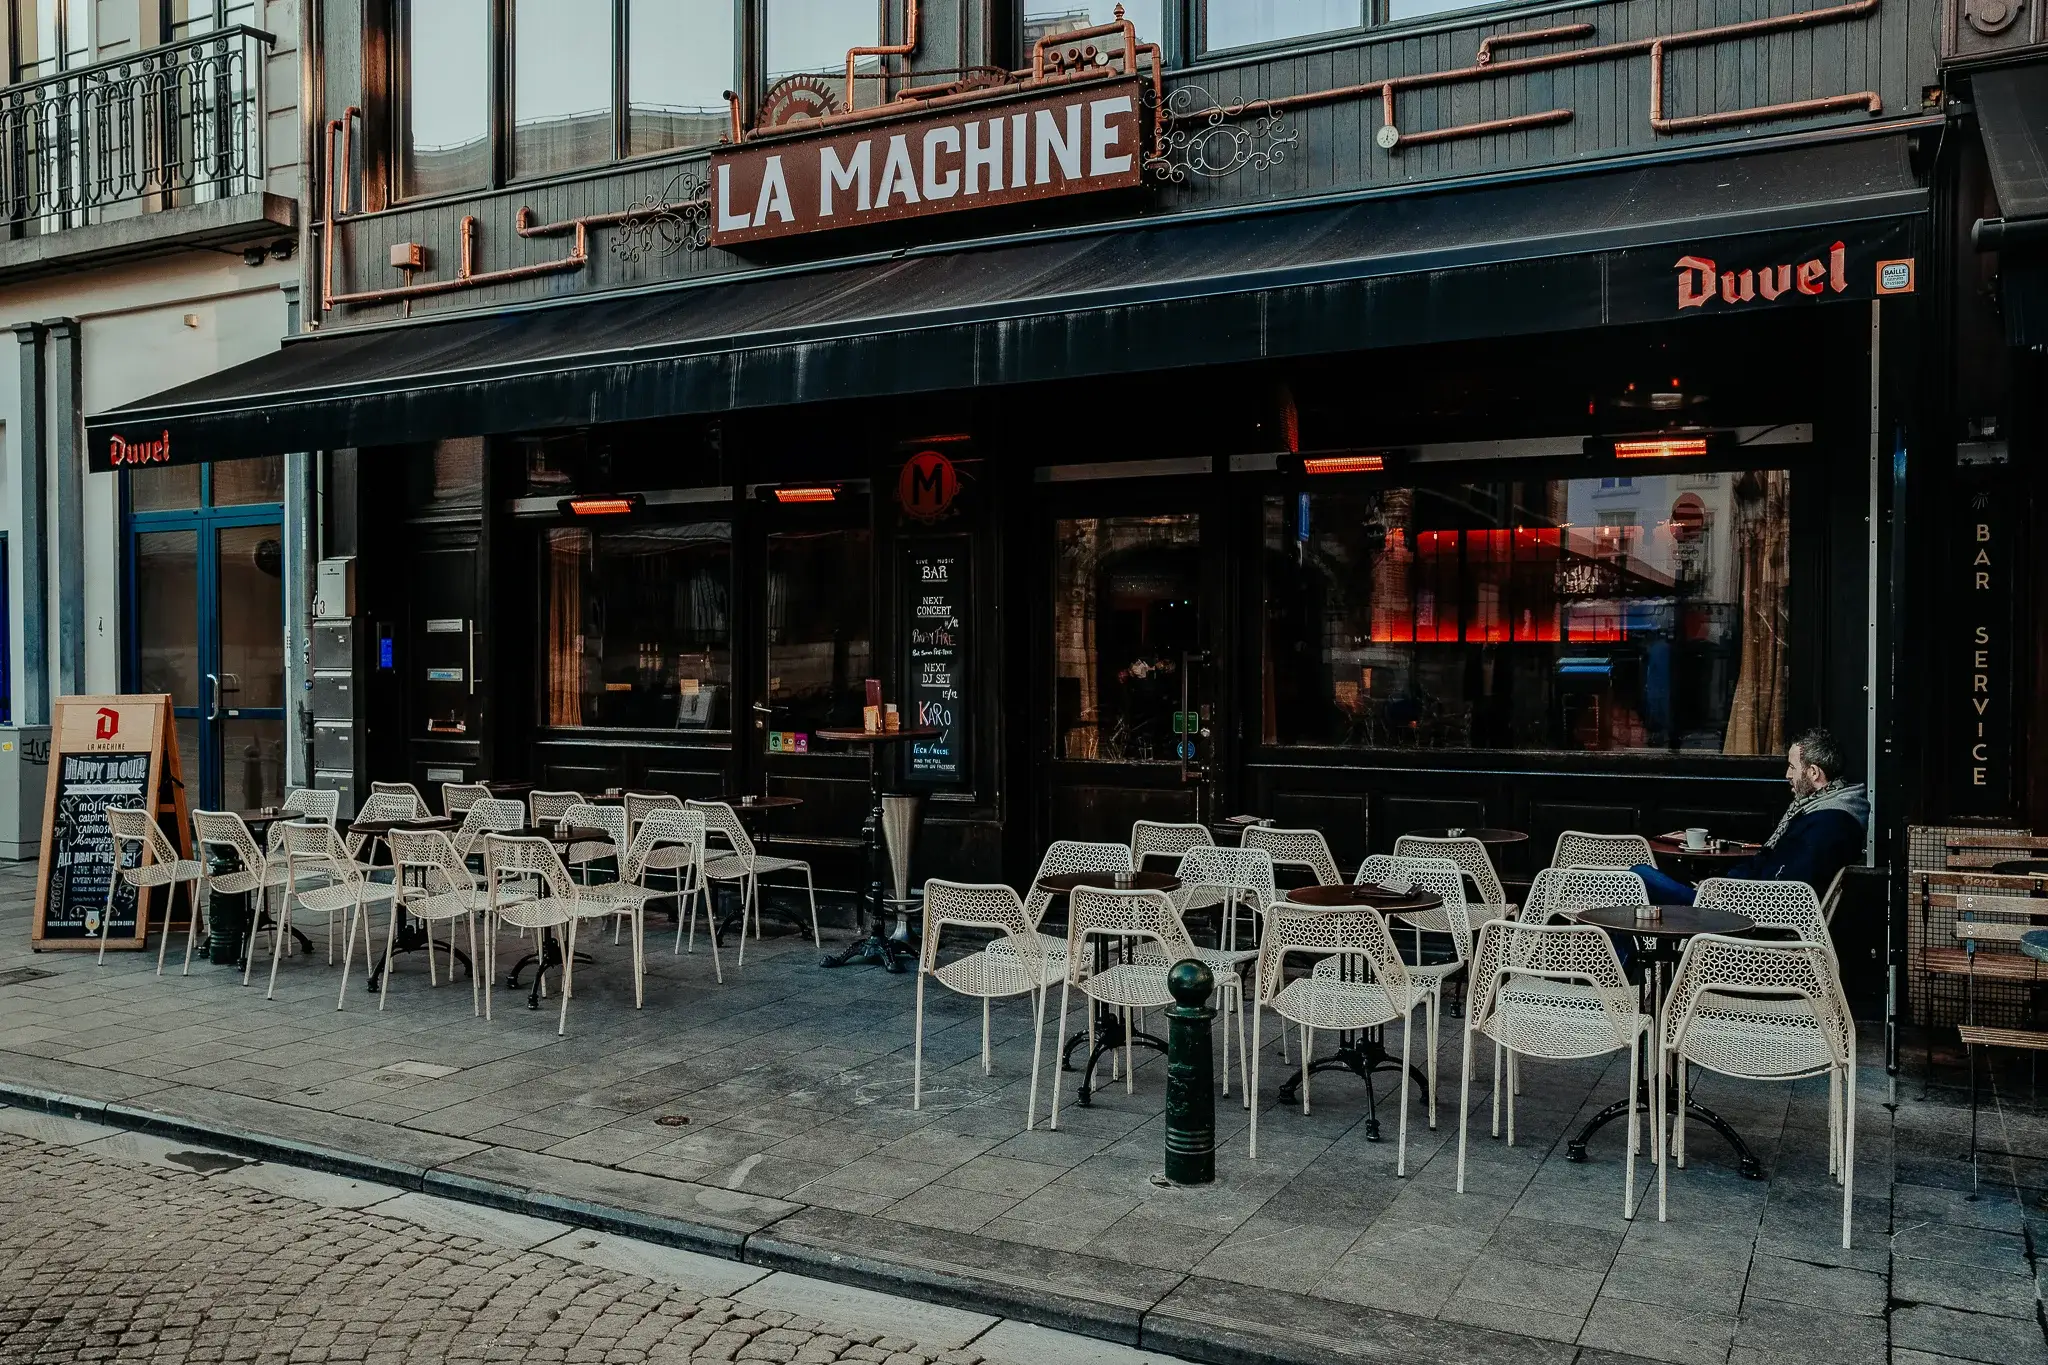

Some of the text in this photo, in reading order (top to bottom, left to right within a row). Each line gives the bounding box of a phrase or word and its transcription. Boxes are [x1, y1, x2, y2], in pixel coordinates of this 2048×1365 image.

[717, 95, 1133, 232] LA MACHINE
[1674, 241, 1848, 309] Duvel
[110, 429, 170, 466] Duvel
[913, 463, 942, 505] M
[922, 565, 949, 579] BAR
[916, 606, 952, 615] CONCERT
[922, 596, 944, 605] NEXT
[1972, 523, 1991, 785] BAR SERVICE
[924, 663, 947, 672] NEXT
[922, 673, 951, 684] DJ SET
[918, 701, 952, 726] KARO
[65, 756, 105, 780] HAPPY
[79, 801, 123, 813] mojitos
[57, 852, 73, 869] ALL
